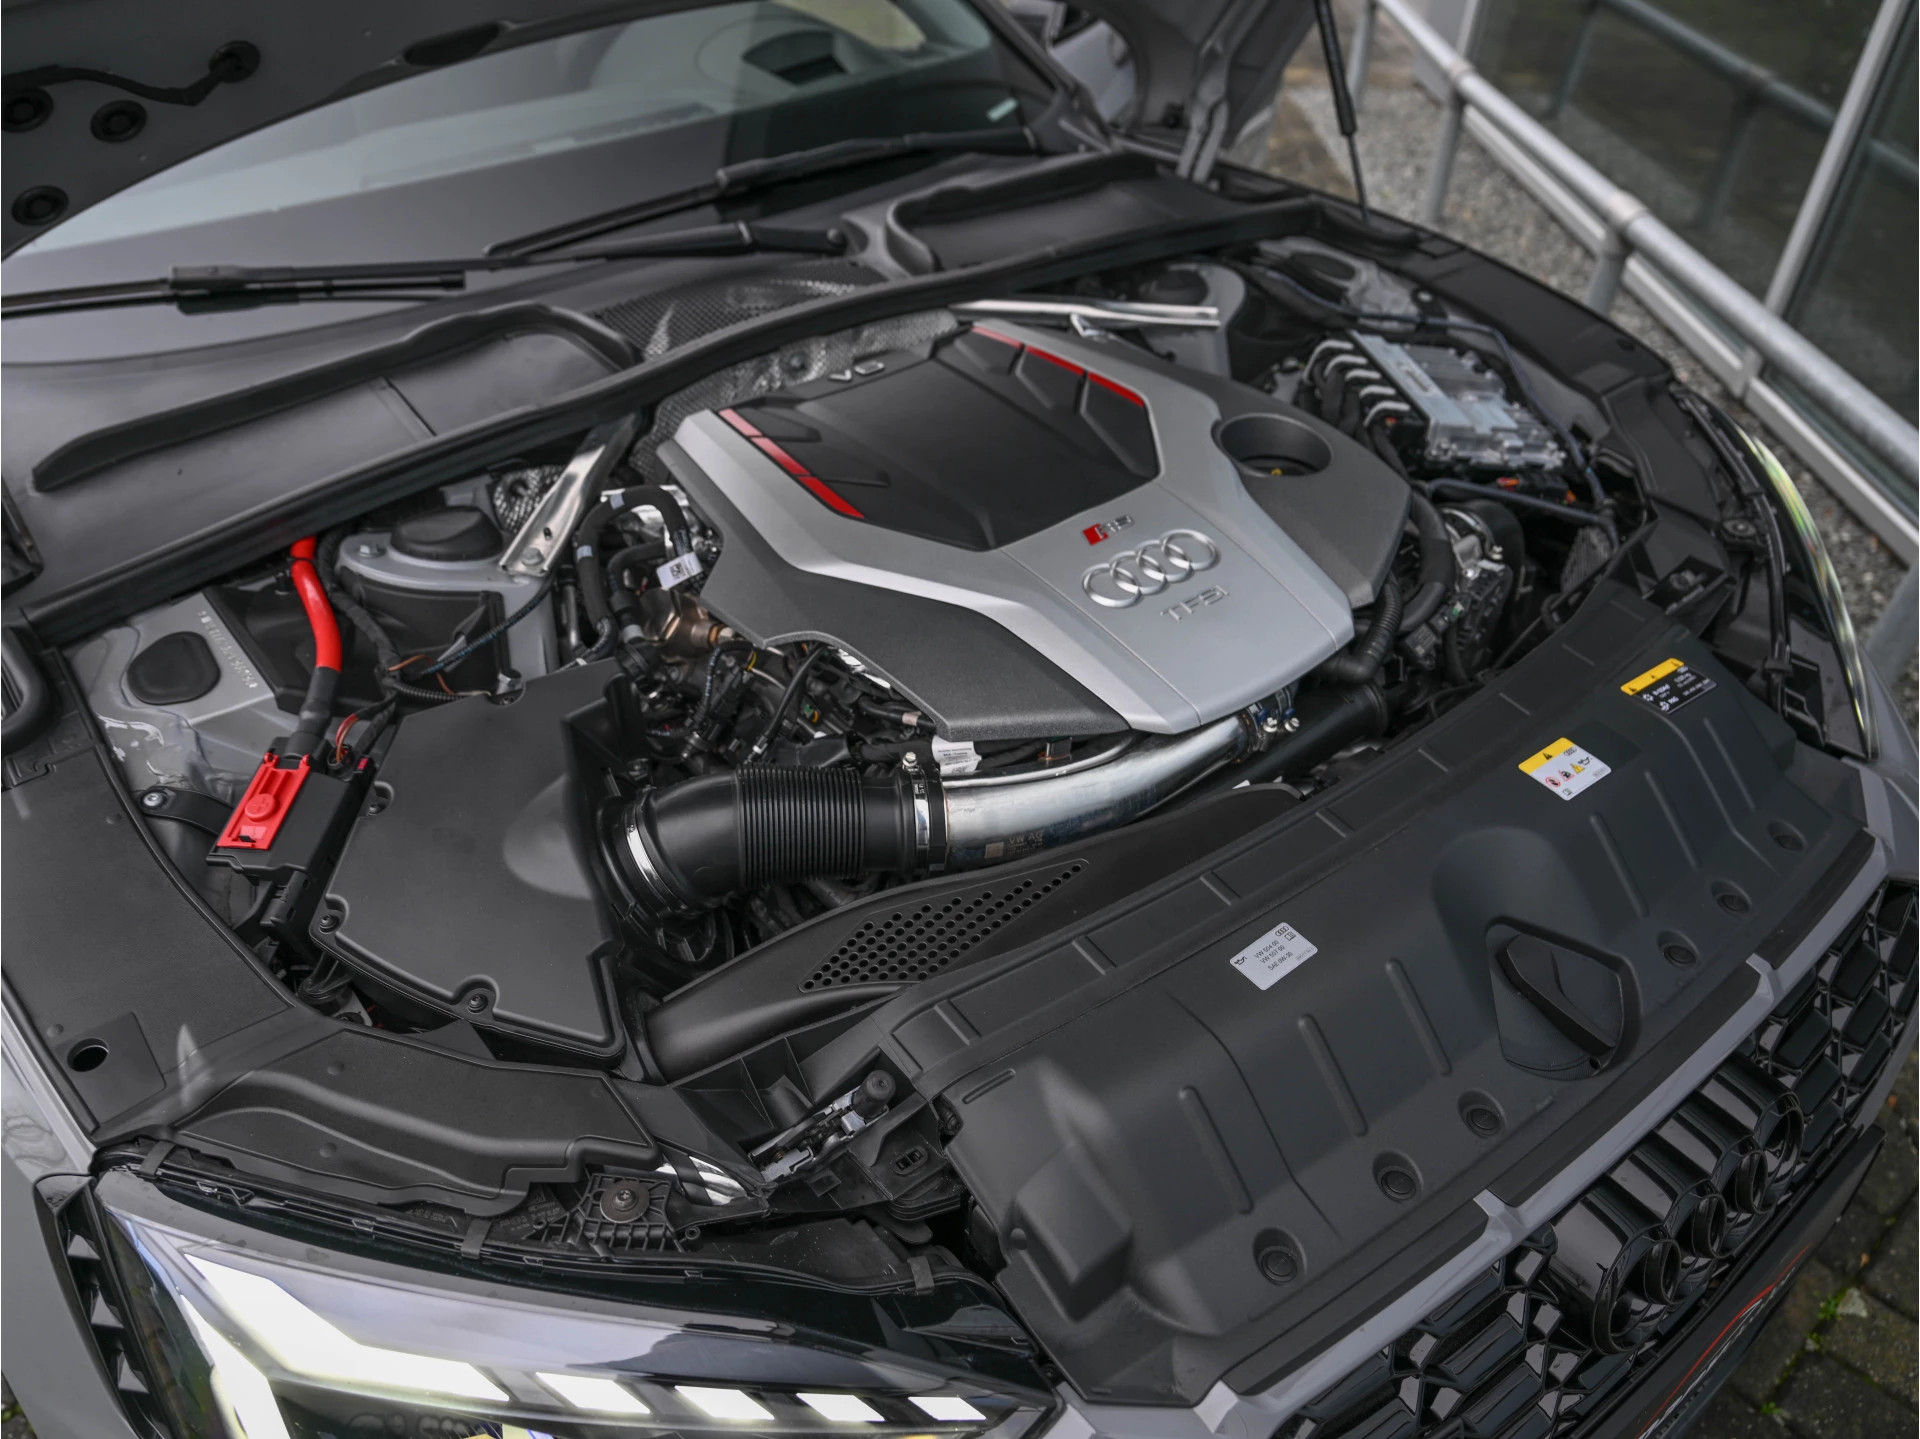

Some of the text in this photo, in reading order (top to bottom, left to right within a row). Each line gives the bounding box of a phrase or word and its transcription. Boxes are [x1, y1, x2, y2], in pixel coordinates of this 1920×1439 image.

[1160, 585, 1229, 622] TFSI
[1254, 950, 1264, 959] VW
[1260, 955, 1270, 964] VW
